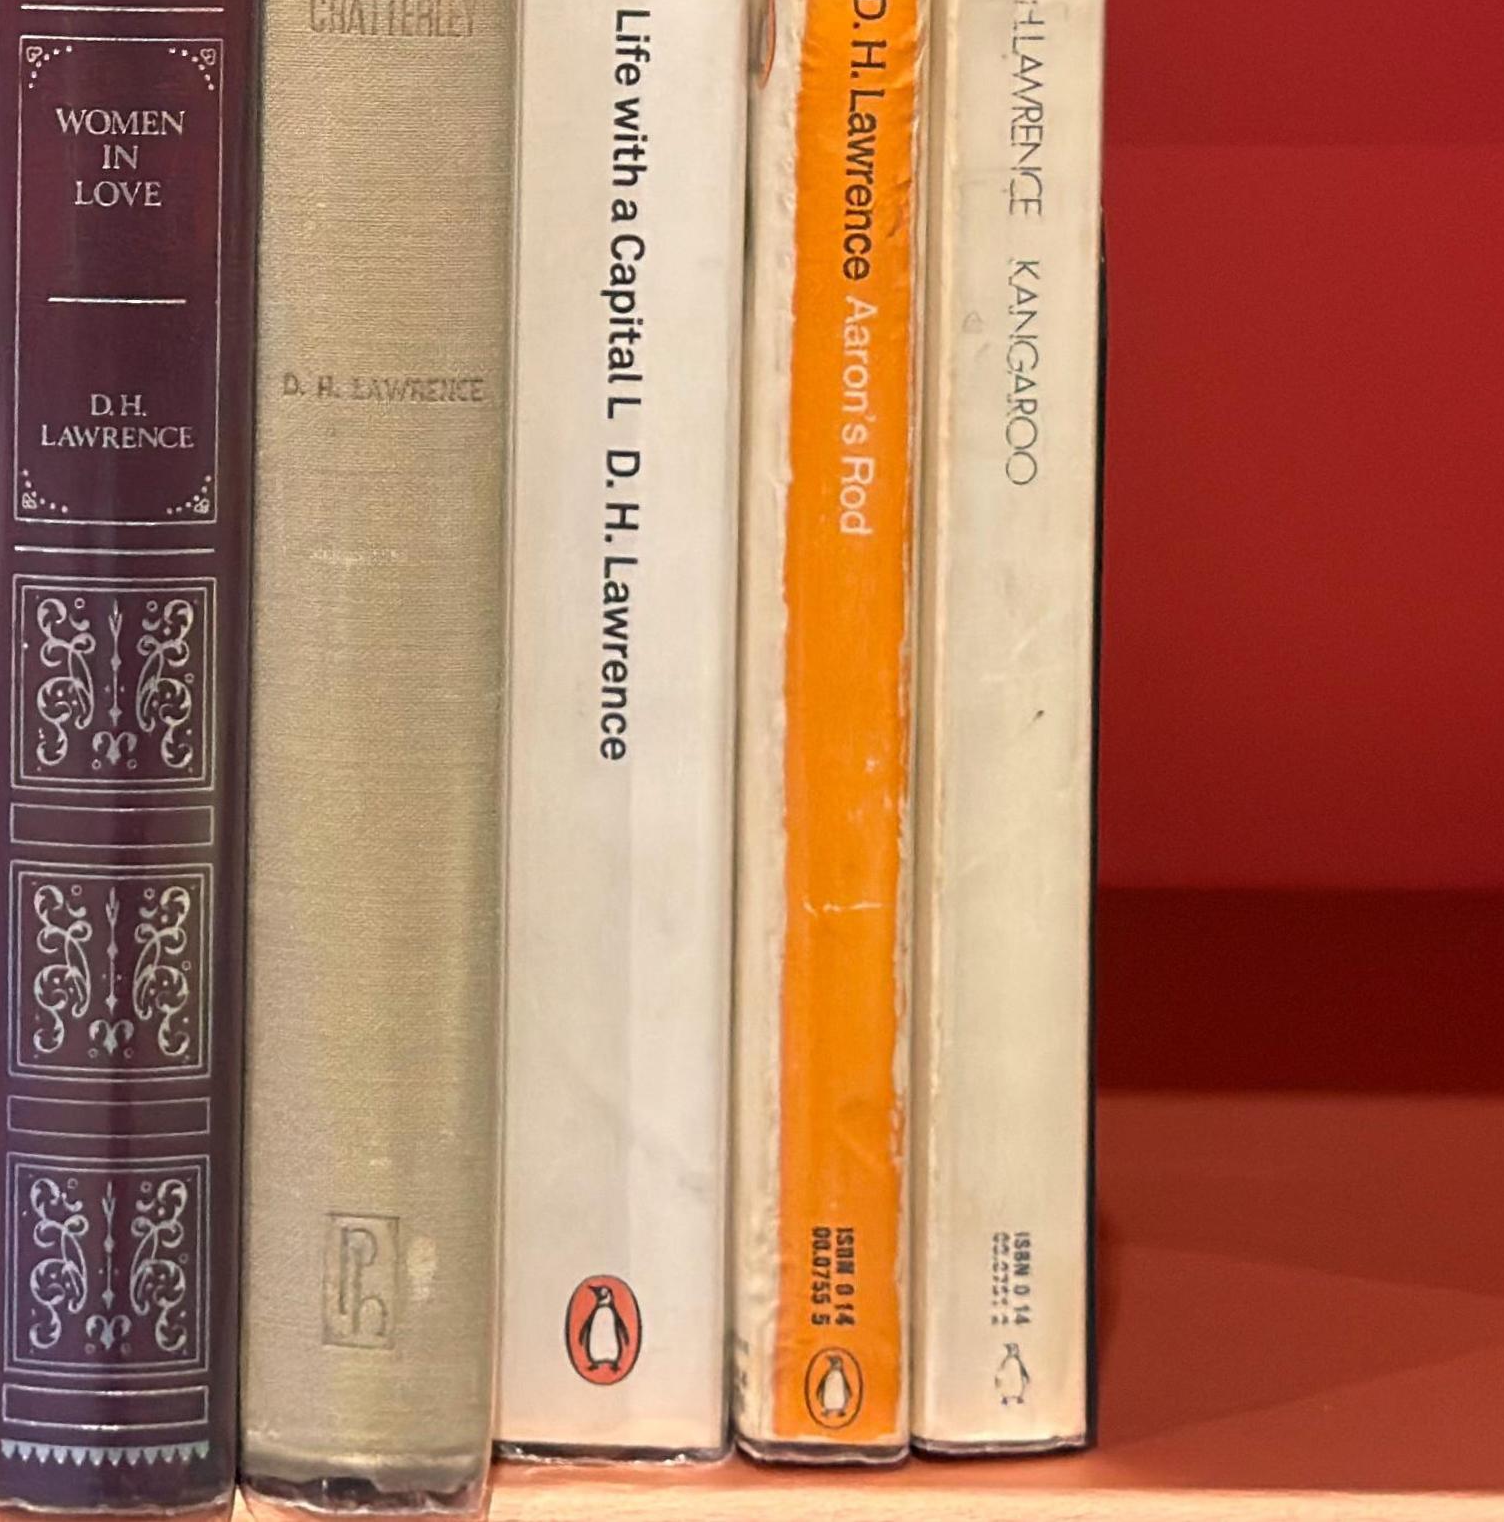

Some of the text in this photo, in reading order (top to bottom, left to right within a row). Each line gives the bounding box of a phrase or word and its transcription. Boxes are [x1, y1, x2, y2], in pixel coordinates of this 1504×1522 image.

[56, 108, 185, 136] WOMEN
[102, 144, 137, 169] IN
[842, 88, 885, 281] Lawrence
[74, 181, 162, 207] LOVE
[600, 8, 650, 761] Life with a Capital L D. H. Lawrence
[841, 293, 878, 444] Aaron's
[1006, 258, 1040, 487] KANGAROO
[41, 423, 195, 448] LAWRENCE
[838, 455, 875, 536] Rod
[1014, 1232, 1030, 1277] ISBN
